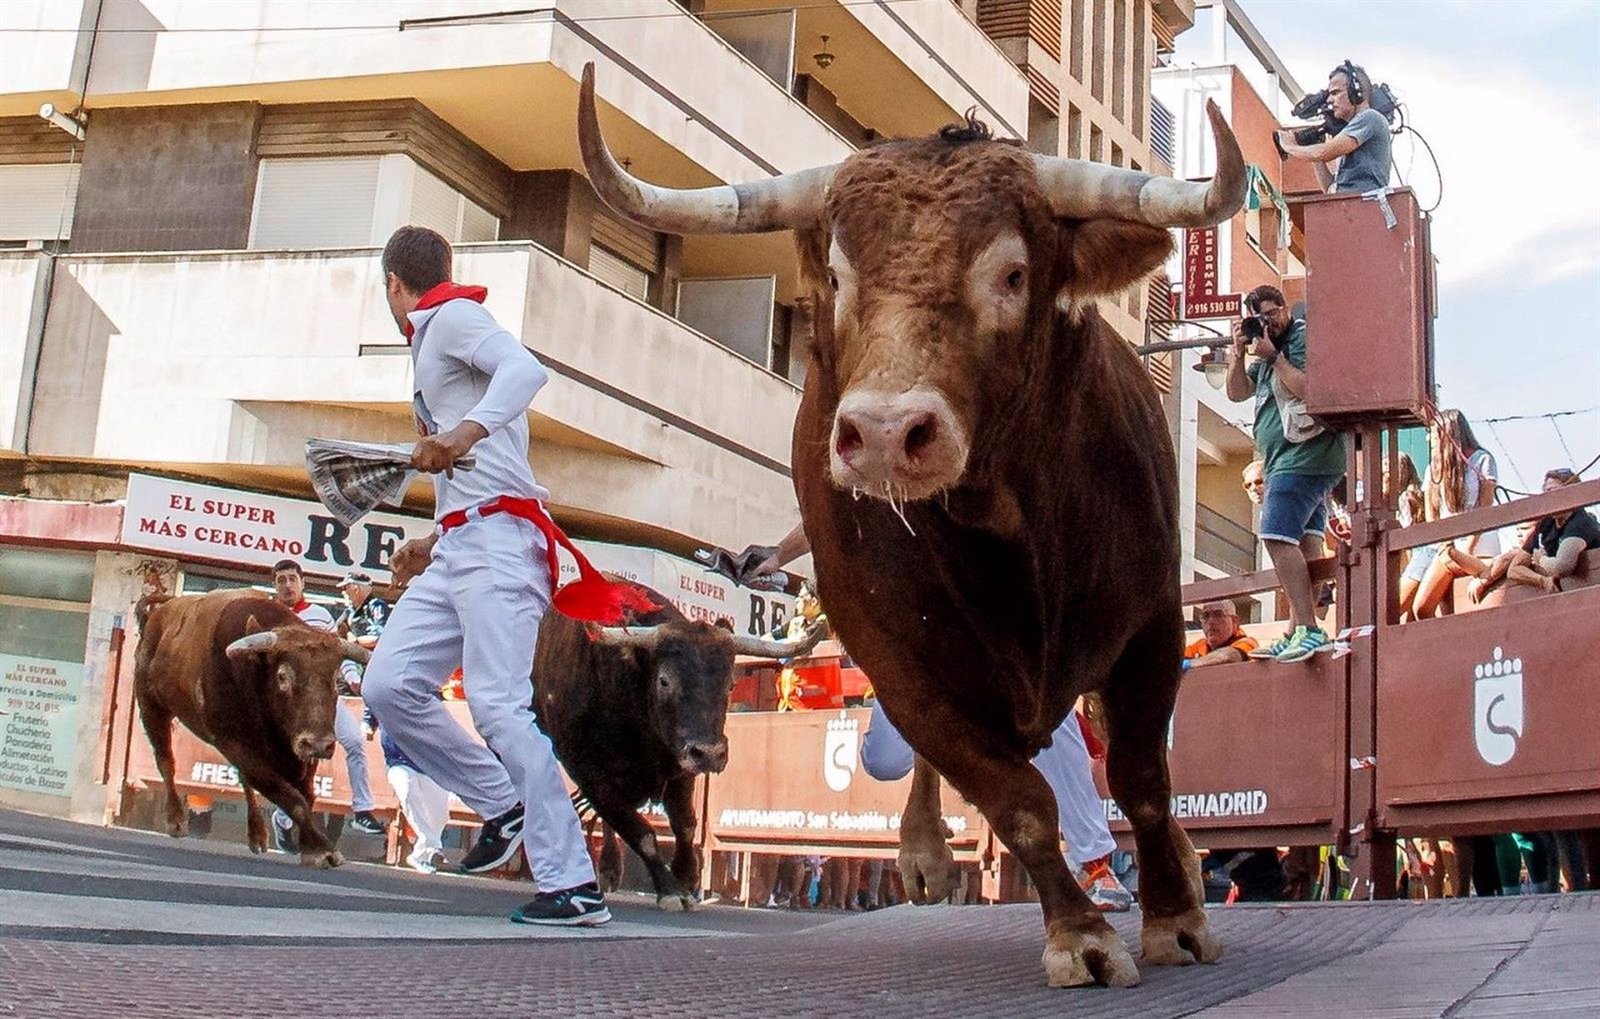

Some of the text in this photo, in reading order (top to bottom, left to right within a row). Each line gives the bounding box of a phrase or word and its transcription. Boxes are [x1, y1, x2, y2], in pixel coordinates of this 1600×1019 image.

[1194, 300, 1239, 314] 916 530 831
[169, 494, 276, 525] EL SUPER
[139, 516, 303, 556] MÁS CERCANO
[680, 575, 726, 601] EL SUPER
[16, 664, 57, 676] EL SUPER
[25, 675, 67, 687] CERCANO
[719, 808, 806, 829] AYUNTAMIENTO
[807, 810, 829, 829] San
